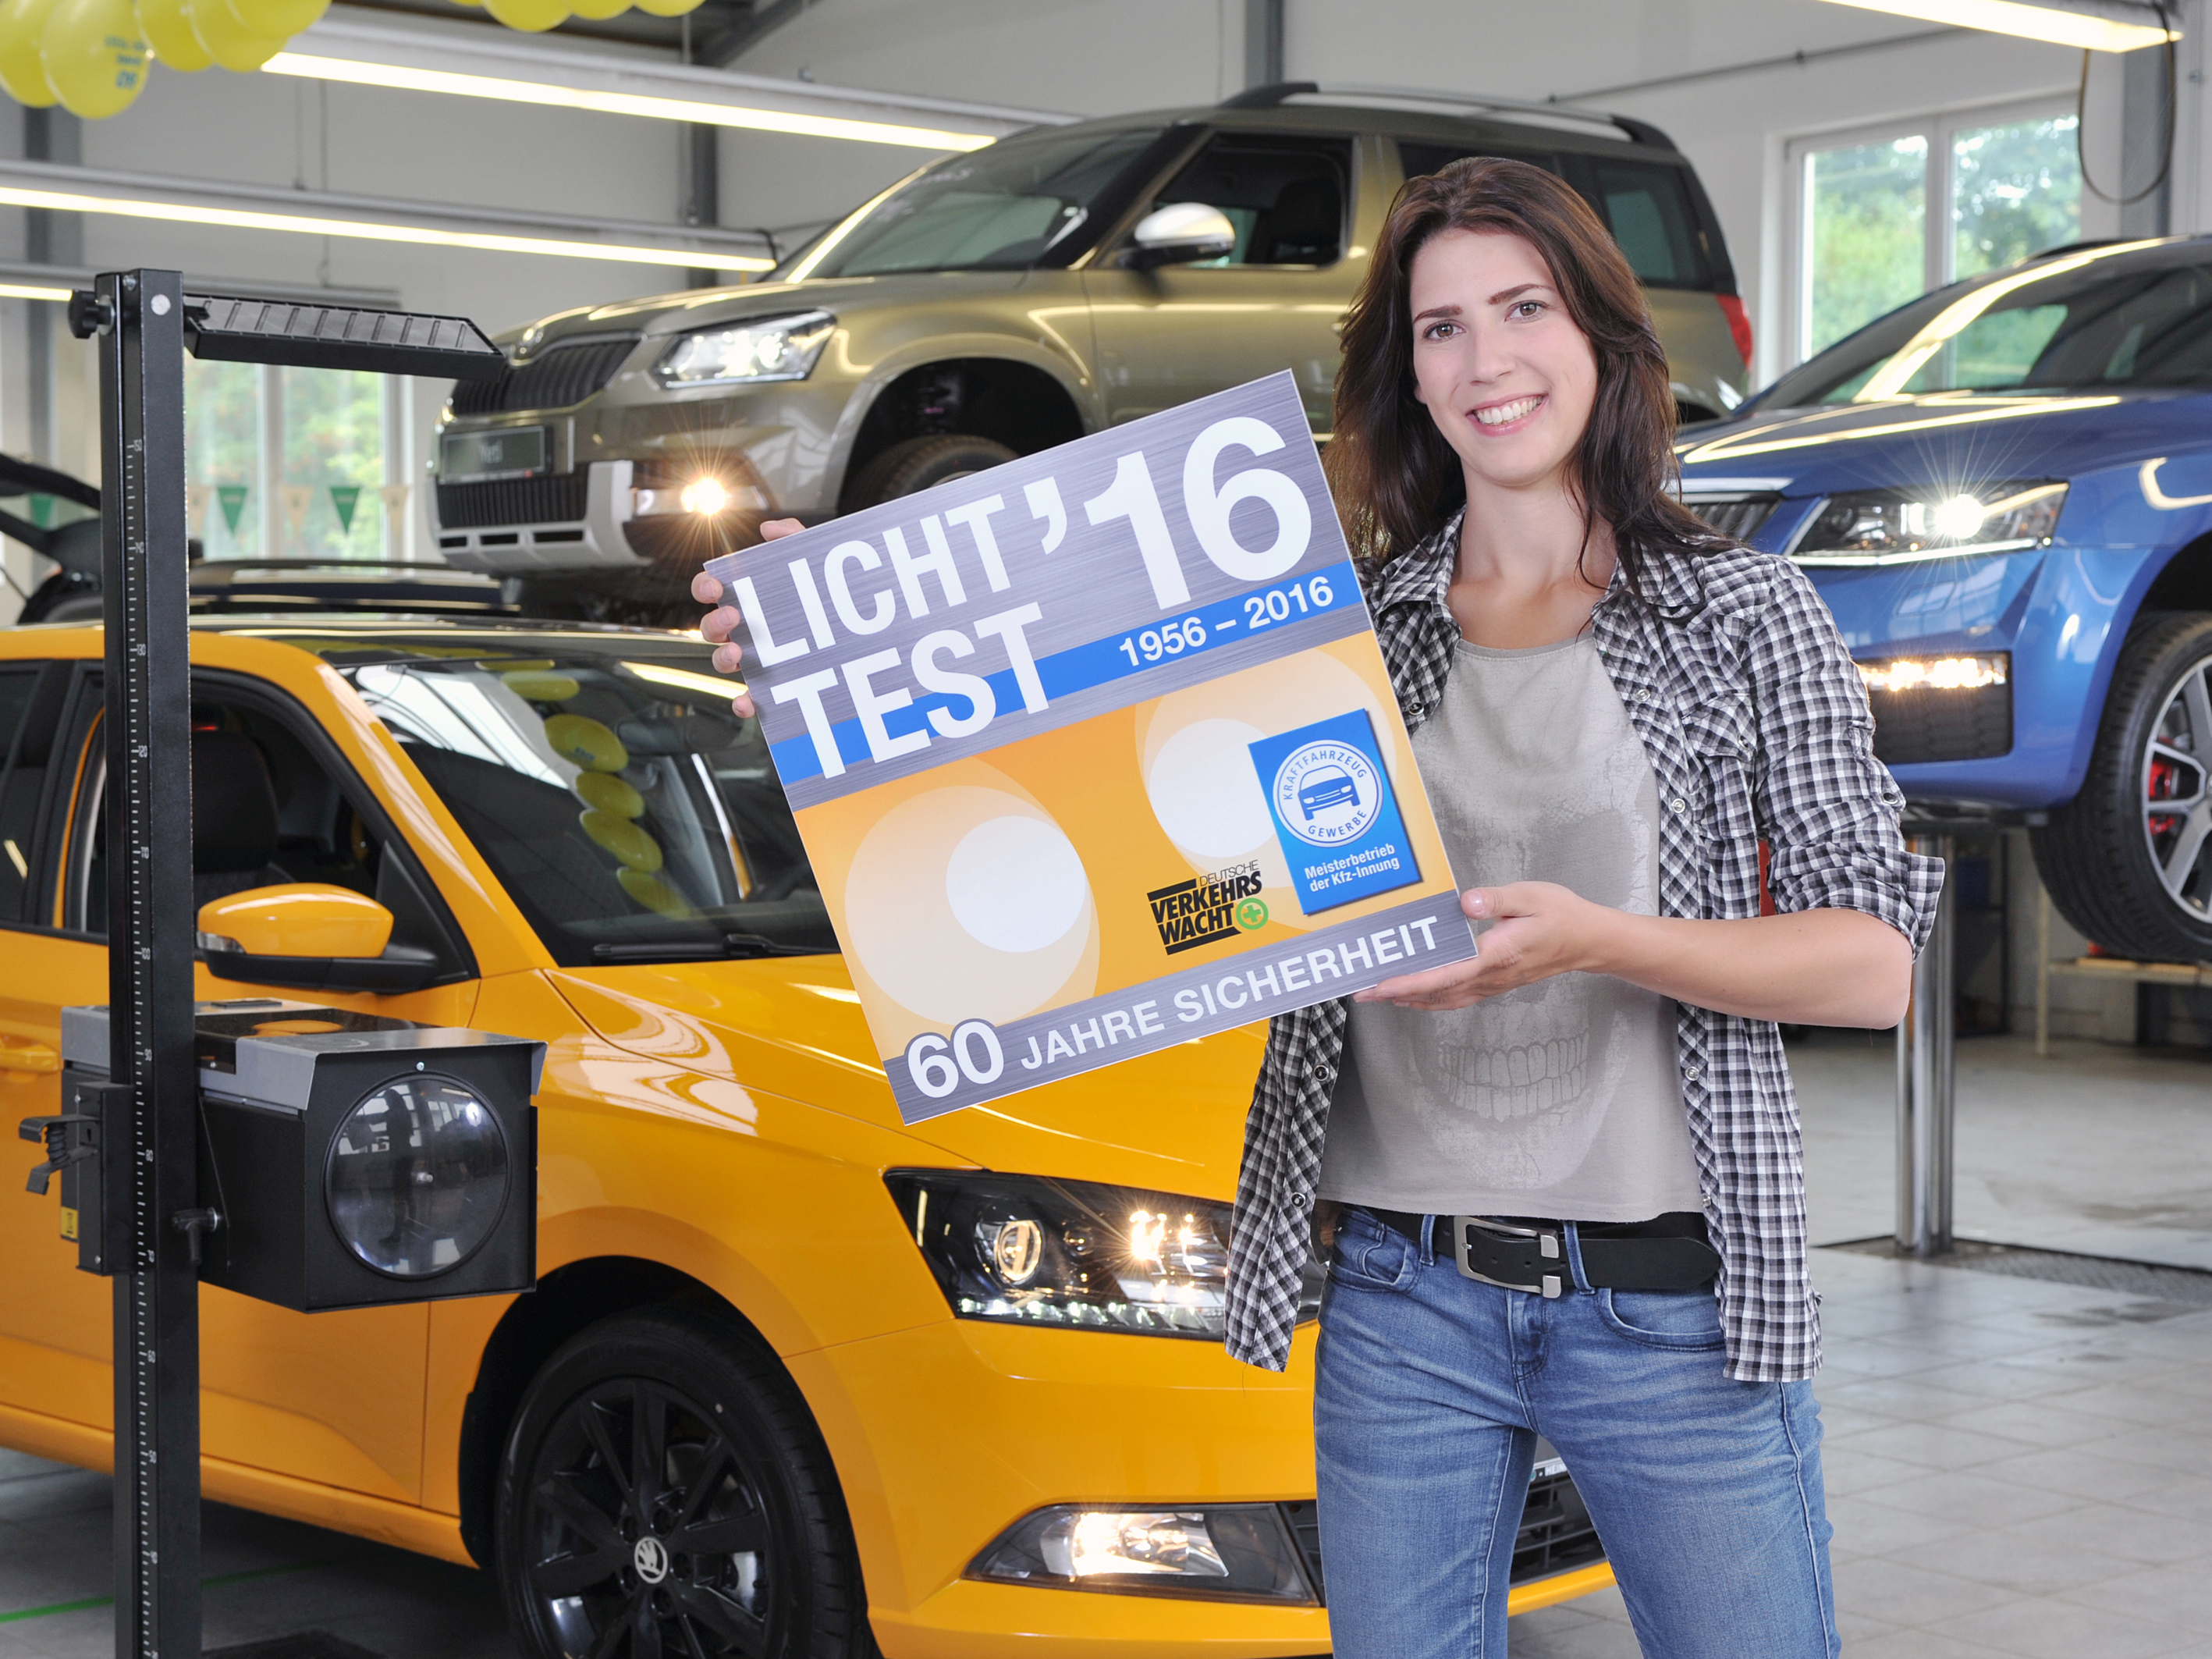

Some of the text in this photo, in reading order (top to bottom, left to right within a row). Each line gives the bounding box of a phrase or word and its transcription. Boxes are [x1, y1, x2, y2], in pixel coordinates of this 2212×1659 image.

[732, 494, 1011, 668] LICHT
[1119, 616, 1207, 666] 1956
[1244, 576, 1334, 630] 2016
[769, 602, 1049, 780] TEST
[1283, 749, 1368, 801] KRAFTFAHRZEUG
[1307, 809, 1368, 839] GEWERBE
[1199, 859, 1259, 886] DEUTSCHE
[1304, 843, 1395, 879] Meisterbetrieb
[1309, 857, 1401, 893] der Kfz-Innung
[1149, 870, 1262, 924] VERKEHRS
[1158, 901, 1236, 947] WACHT
[907, 916, 1439, 1098] 60 JAHRE SICHERHEIT
